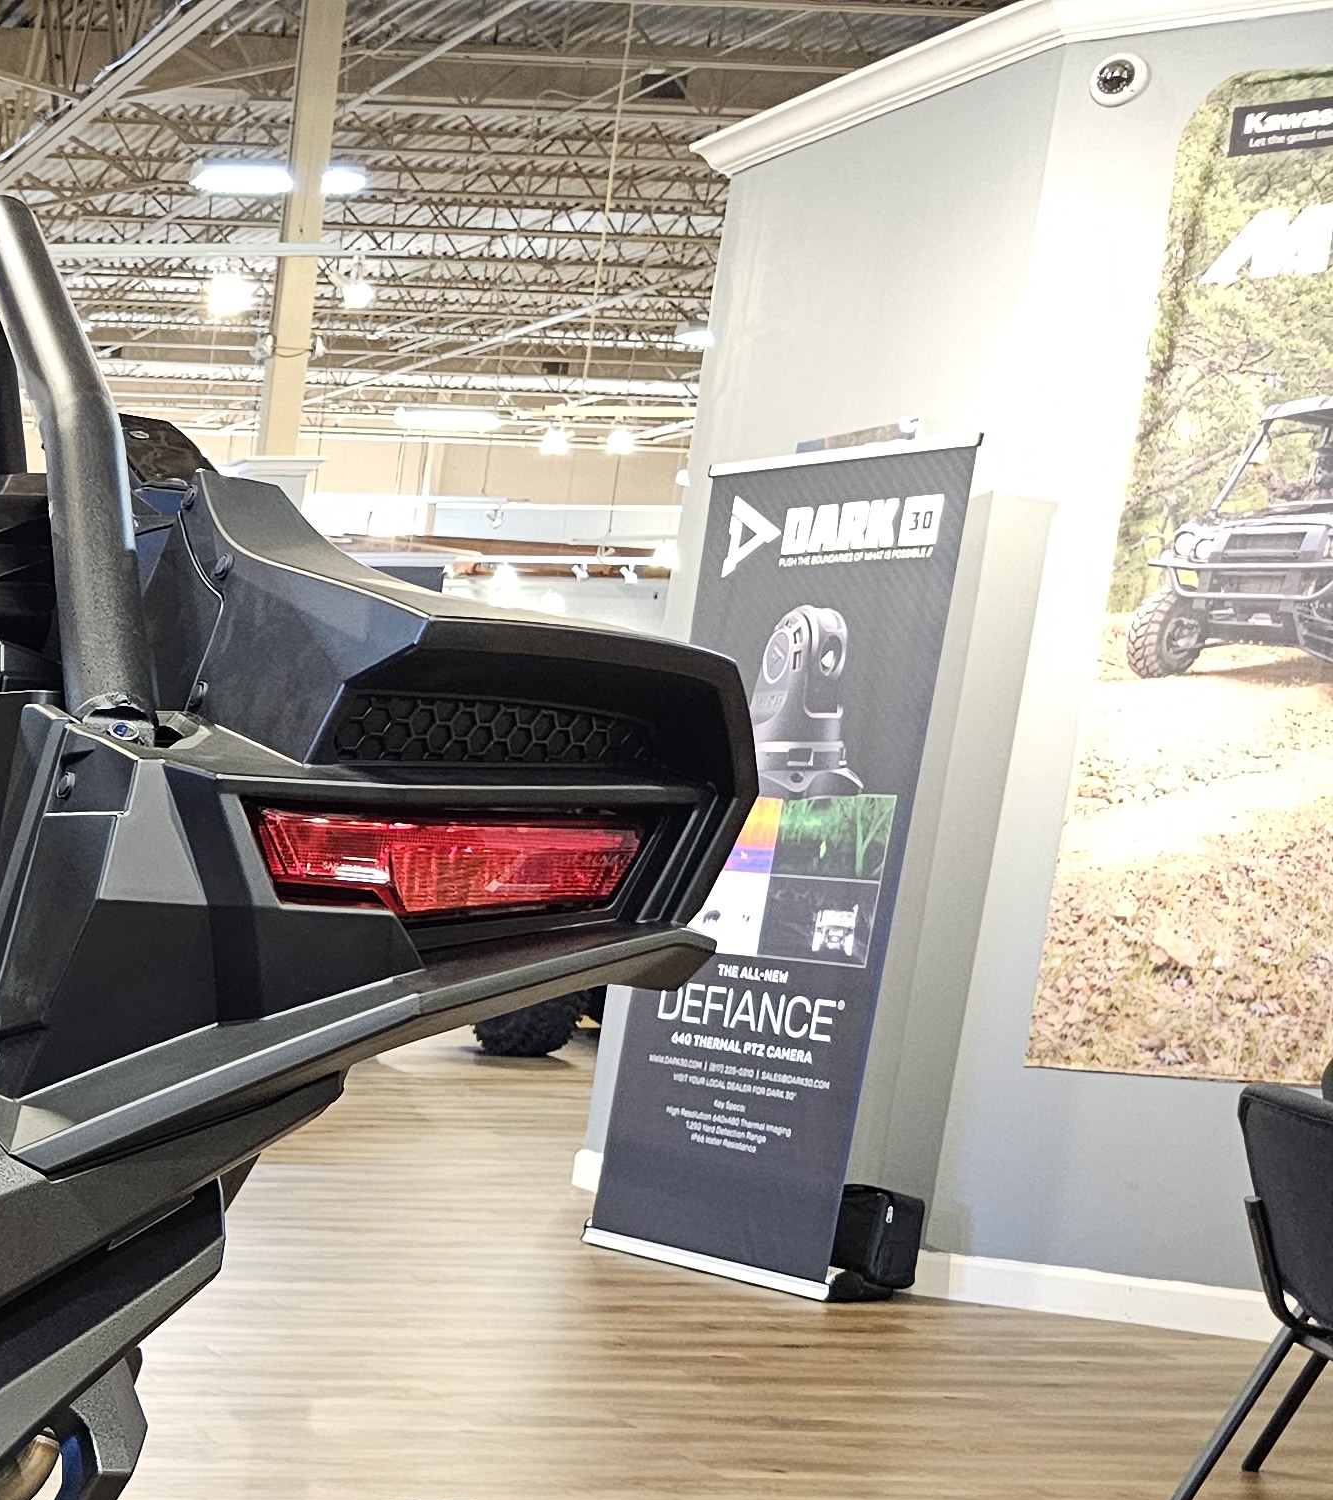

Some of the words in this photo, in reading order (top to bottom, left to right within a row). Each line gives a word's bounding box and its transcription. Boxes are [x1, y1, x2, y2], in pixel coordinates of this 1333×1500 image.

[780, 498, 900, 555] DARK
[717, 963, 739, 979] THE
[671, 1031, 692, 1046] 640
[693, 1034, 742, 1055] THERMAL
[766, 1045, 813, 1064] CAMERA
